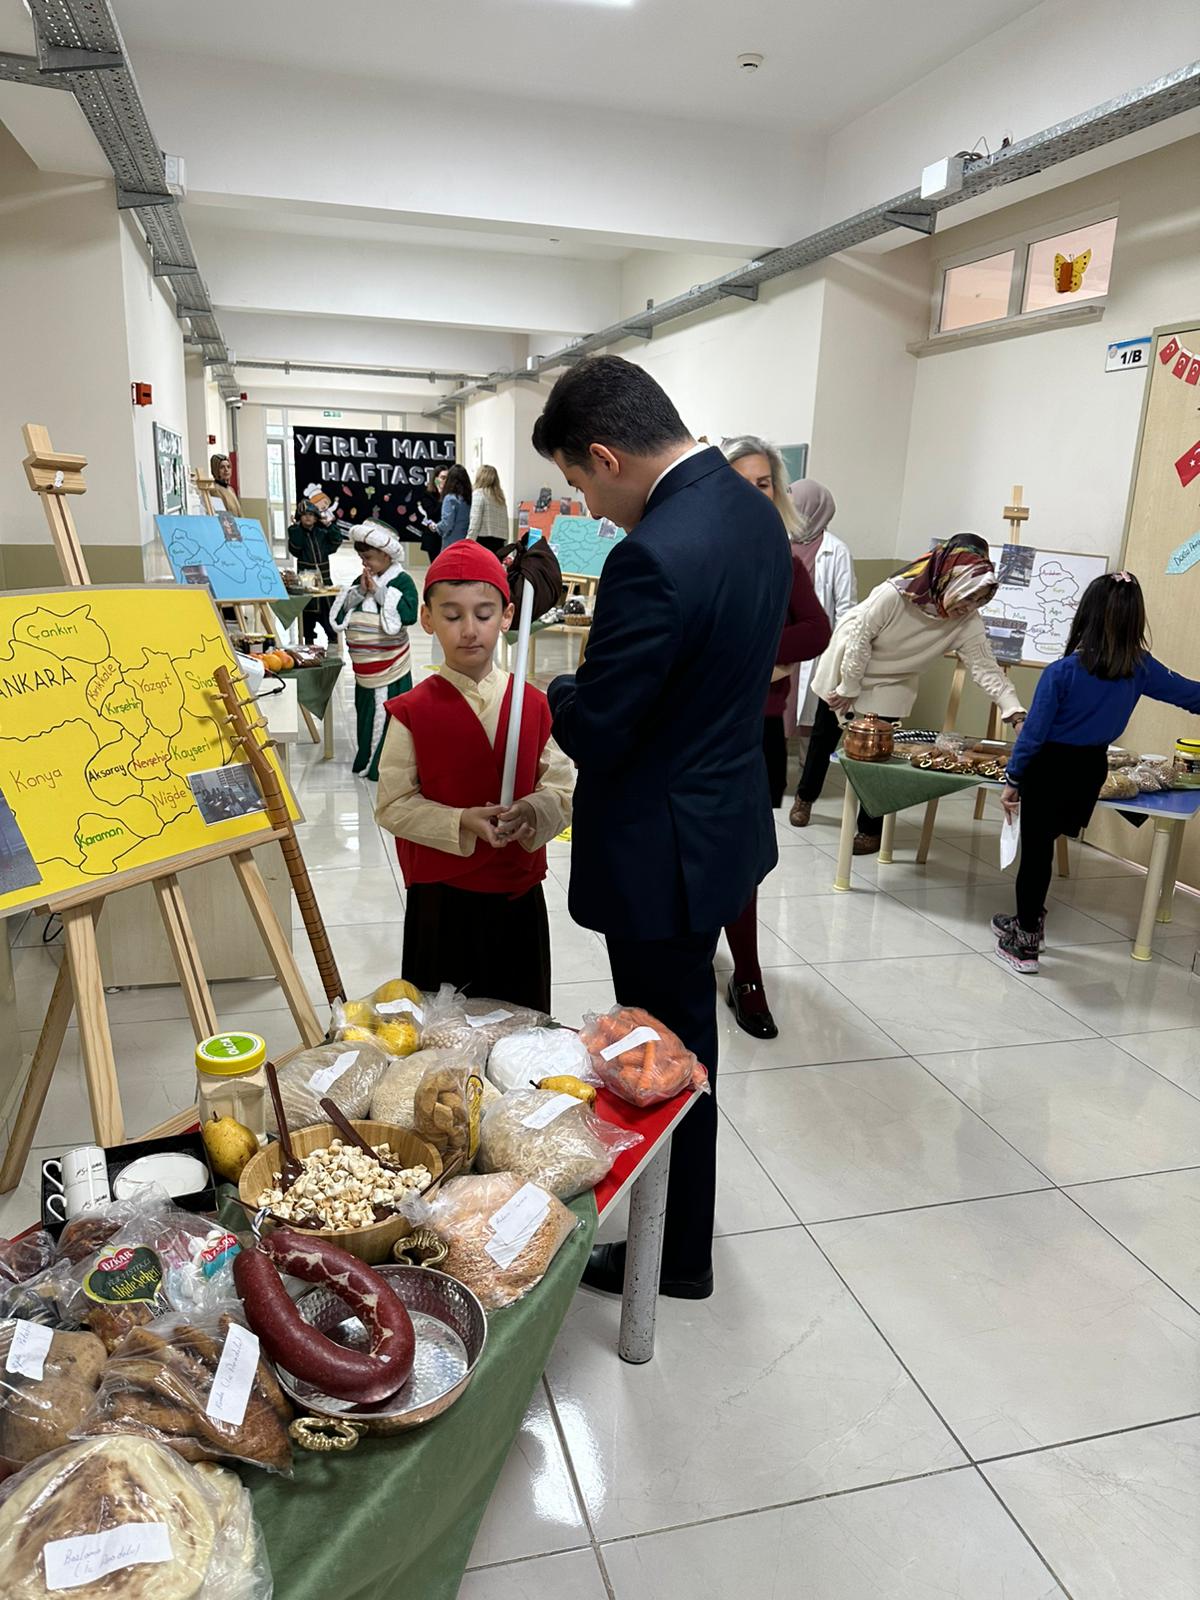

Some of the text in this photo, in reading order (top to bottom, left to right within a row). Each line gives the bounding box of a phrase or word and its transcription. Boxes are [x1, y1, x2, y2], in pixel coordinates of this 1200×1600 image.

[1121, 349, 1142, 364] 1/B
[296, 433, 455, 460] YERLİ MALI
[137, 673, 172, 695] Yozgat
[105, 698, 141, 714] Kırşehir
[171, 737, 211, 761] Kayseri
[133, 751, 169, 771] Nevşehir
[9, 767, 64, 793] Konya
[88, 764, 127, 781] Aksaray
[152, 784, 188, 809] Niğde
[77, 826, 124, 848] Karaman
